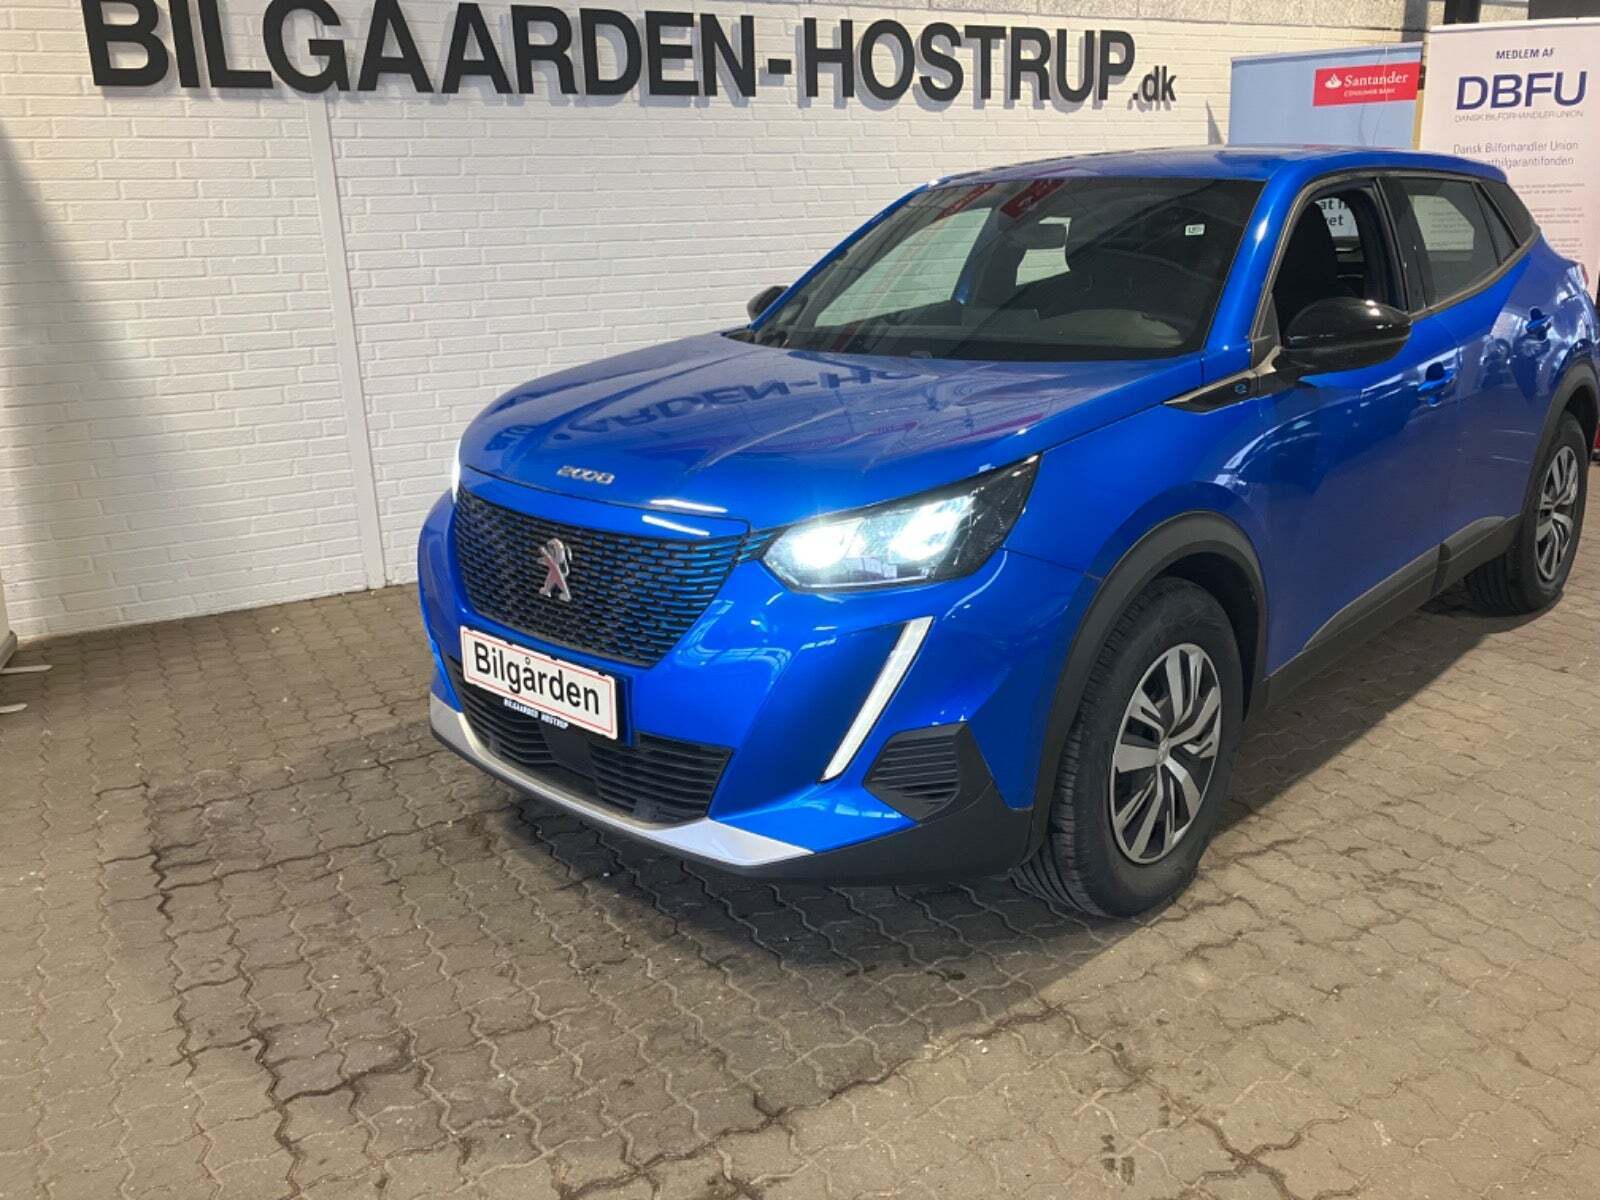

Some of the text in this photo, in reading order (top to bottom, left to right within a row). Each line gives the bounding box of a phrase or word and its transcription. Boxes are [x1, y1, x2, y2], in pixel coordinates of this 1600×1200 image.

[1496, 48, 1555, 60] MEDLEM AF
[1344, 70, 1408, 87] Santander
[1456, 71, 1587, 110] DBFU
[1453, 140, 1579, 155] Dansk Bilforhandler Union
[556, 465, 615, 484] 2008
[474, 641, 600, 715] Bilgården
